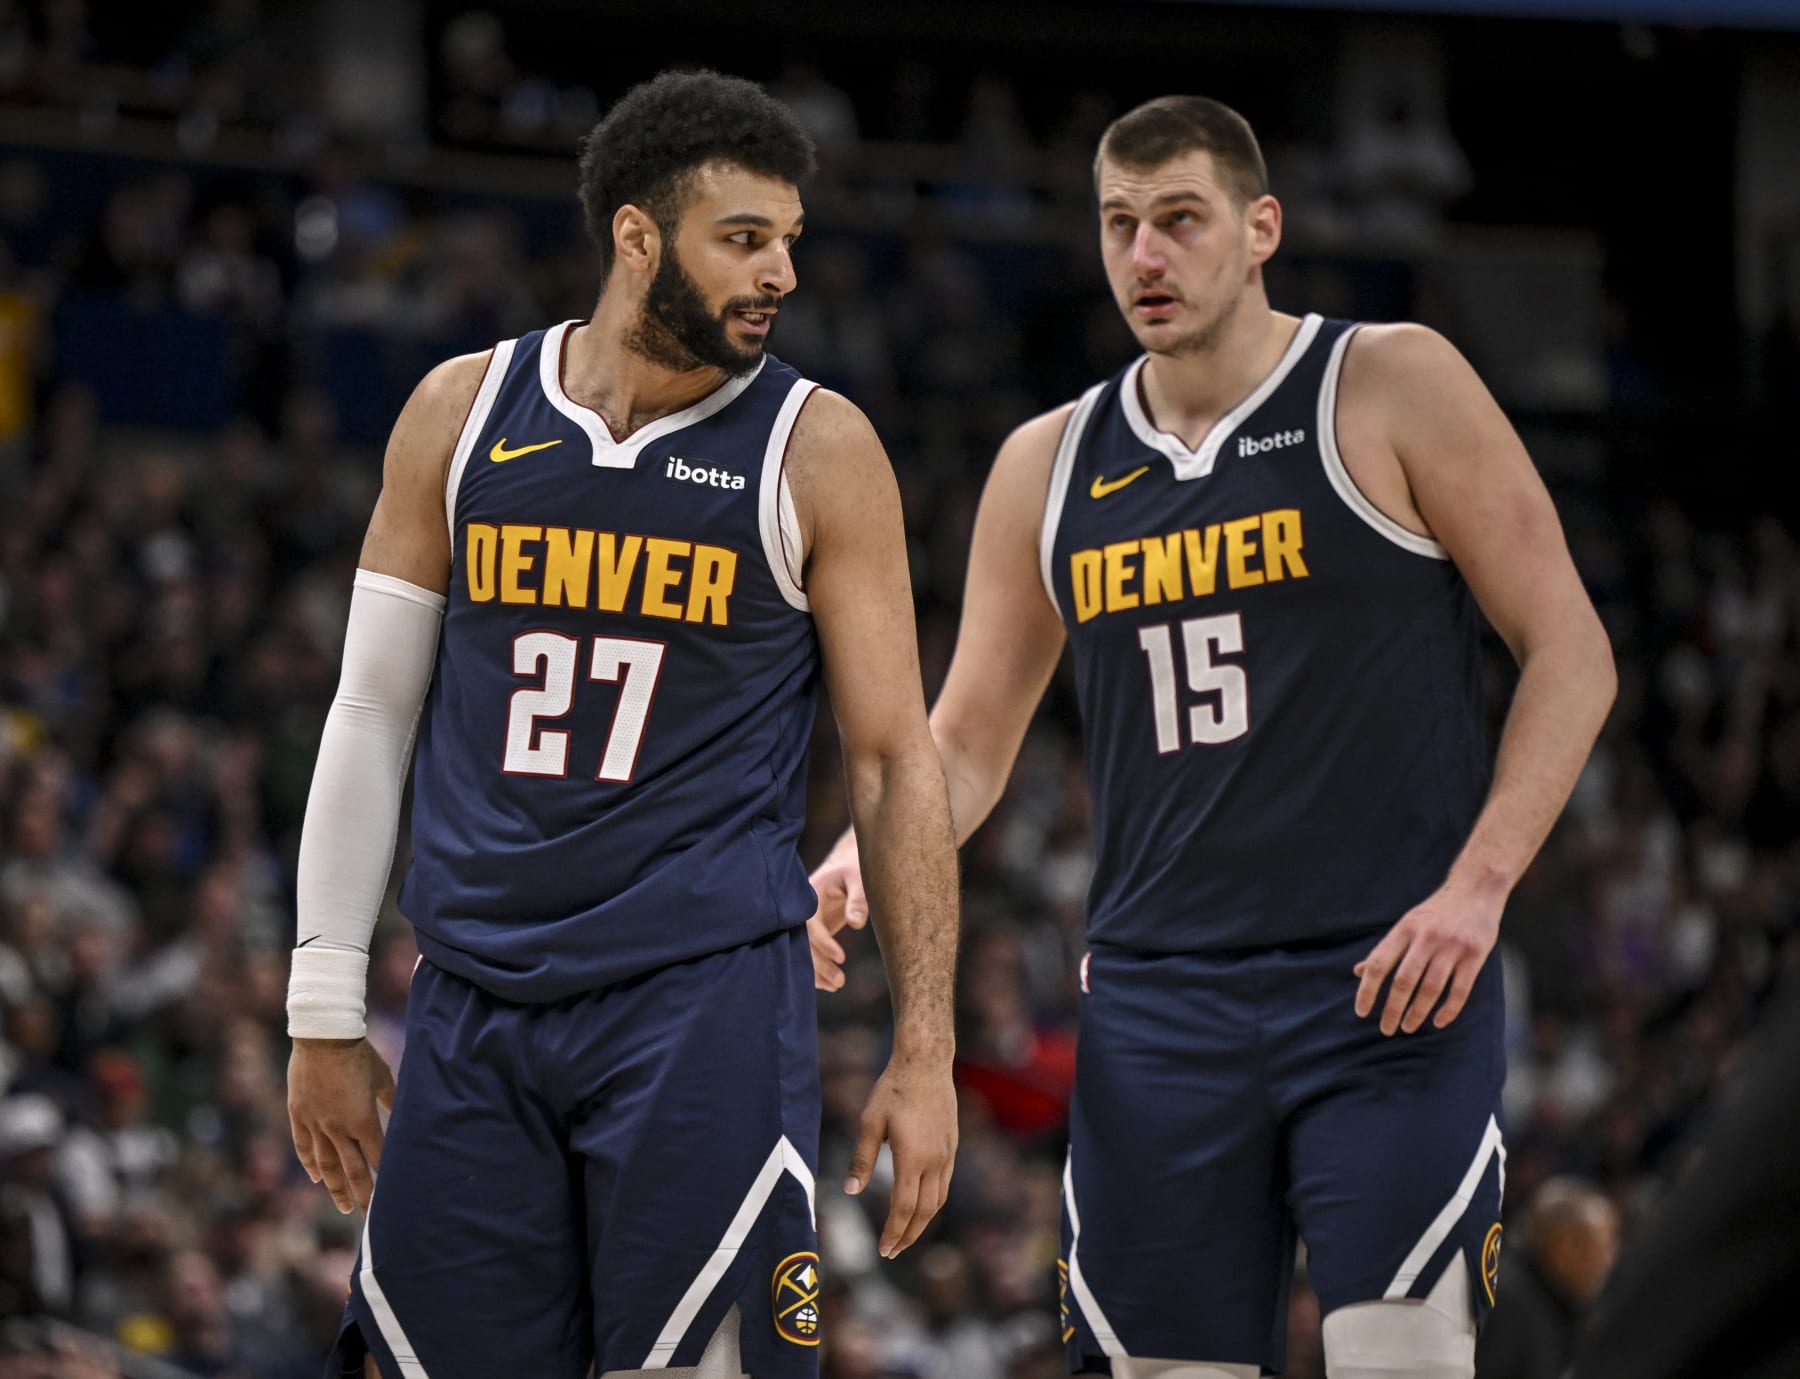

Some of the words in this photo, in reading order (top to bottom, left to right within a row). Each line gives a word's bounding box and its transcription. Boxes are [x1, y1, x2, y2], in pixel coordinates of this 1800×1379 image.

[665, 456, 746, 490] ibotta
[1239, 429, 1305, 457] ibotta
[466, 521, 740, 626] DENVER
[1070, 508, 1310, 624] DENVER
[501, 629, 668, 784] 27
[1137, 611, 1249, 755] 15
